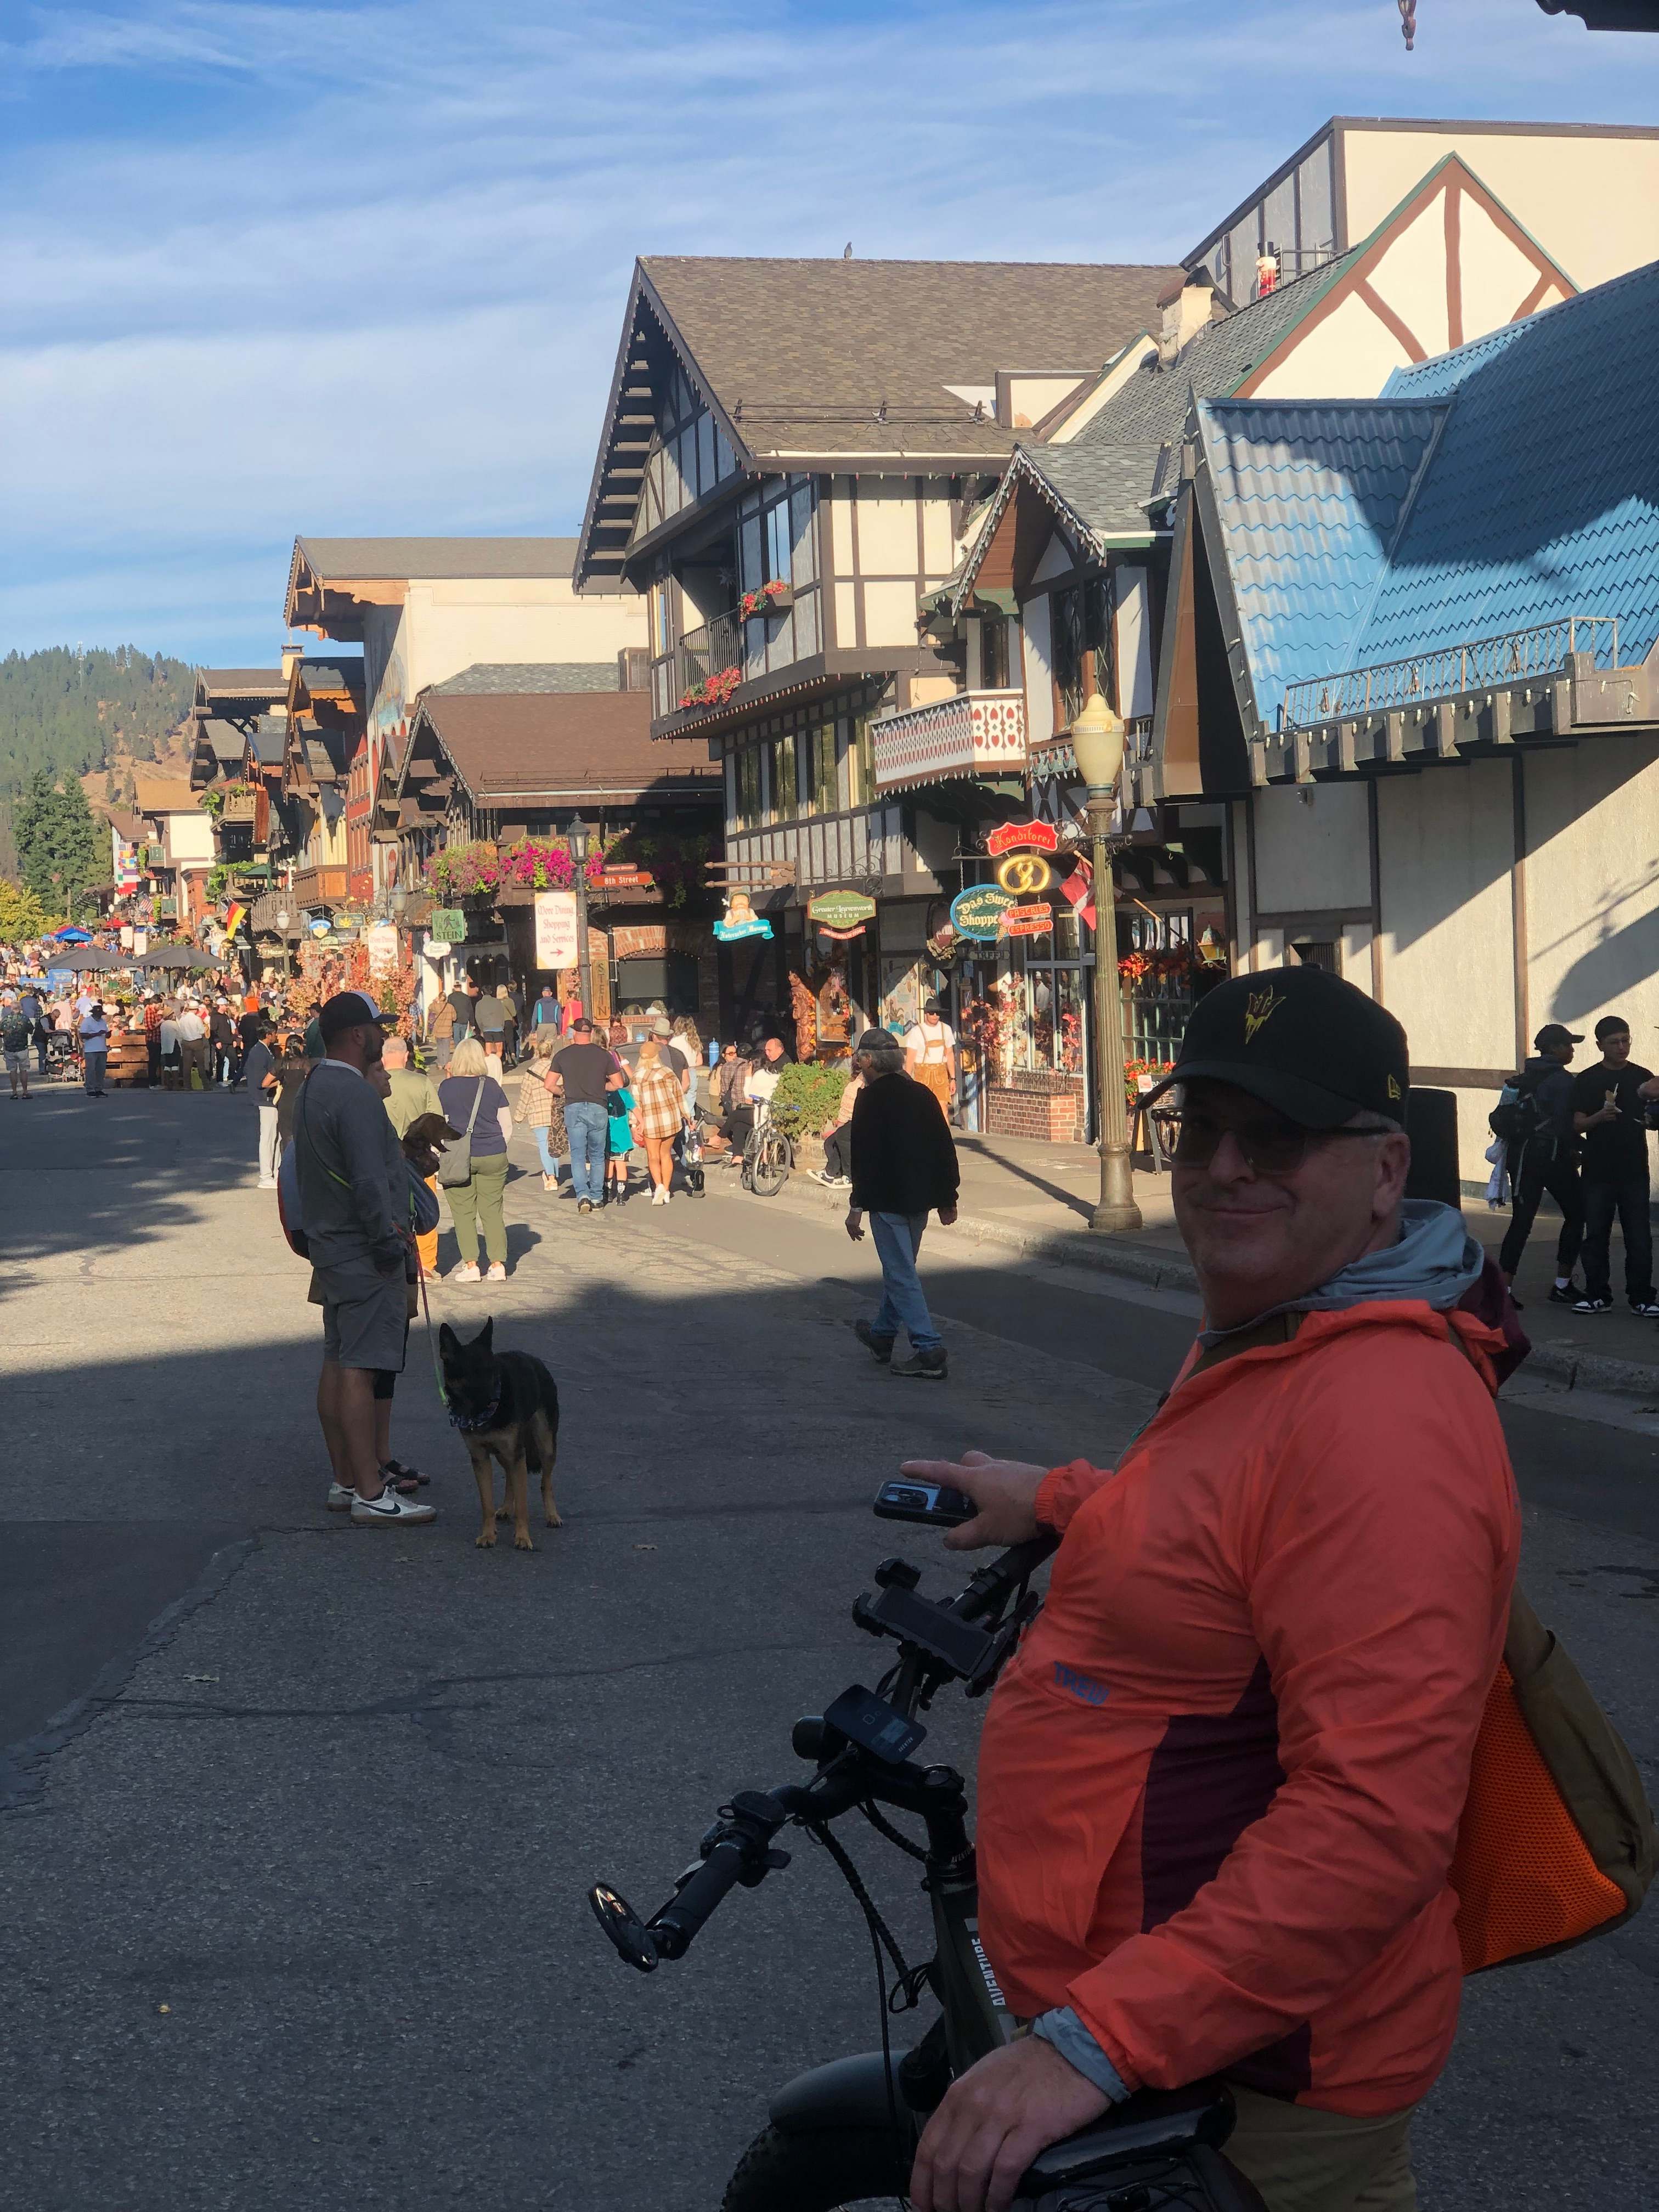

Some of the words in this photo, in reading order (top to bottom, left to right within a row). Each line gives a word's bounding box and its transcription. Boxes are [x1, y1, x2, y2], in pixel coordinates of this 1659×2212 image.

[994, 828, 1052, 849] Konditorei
[618, 876, 639, 884] Street
[812, 906, 836, 914] Greater
[836, 904, 873, 914] Leavenworth
[956, 896, 984, 915] Das
[985, 893, 1015, 909] Swee
[1009, 905, 1049, 917] PASTRIES
[543, 919, 570, 930] Shopping
[1011, 922, 1050, 934] ESPRESSO
[437, 930, 462, 940] STEIN
[540, 934, 551, 944] and
[552, 934, 575, 943] Services
[597, 963, 607, 1016] STEIN
